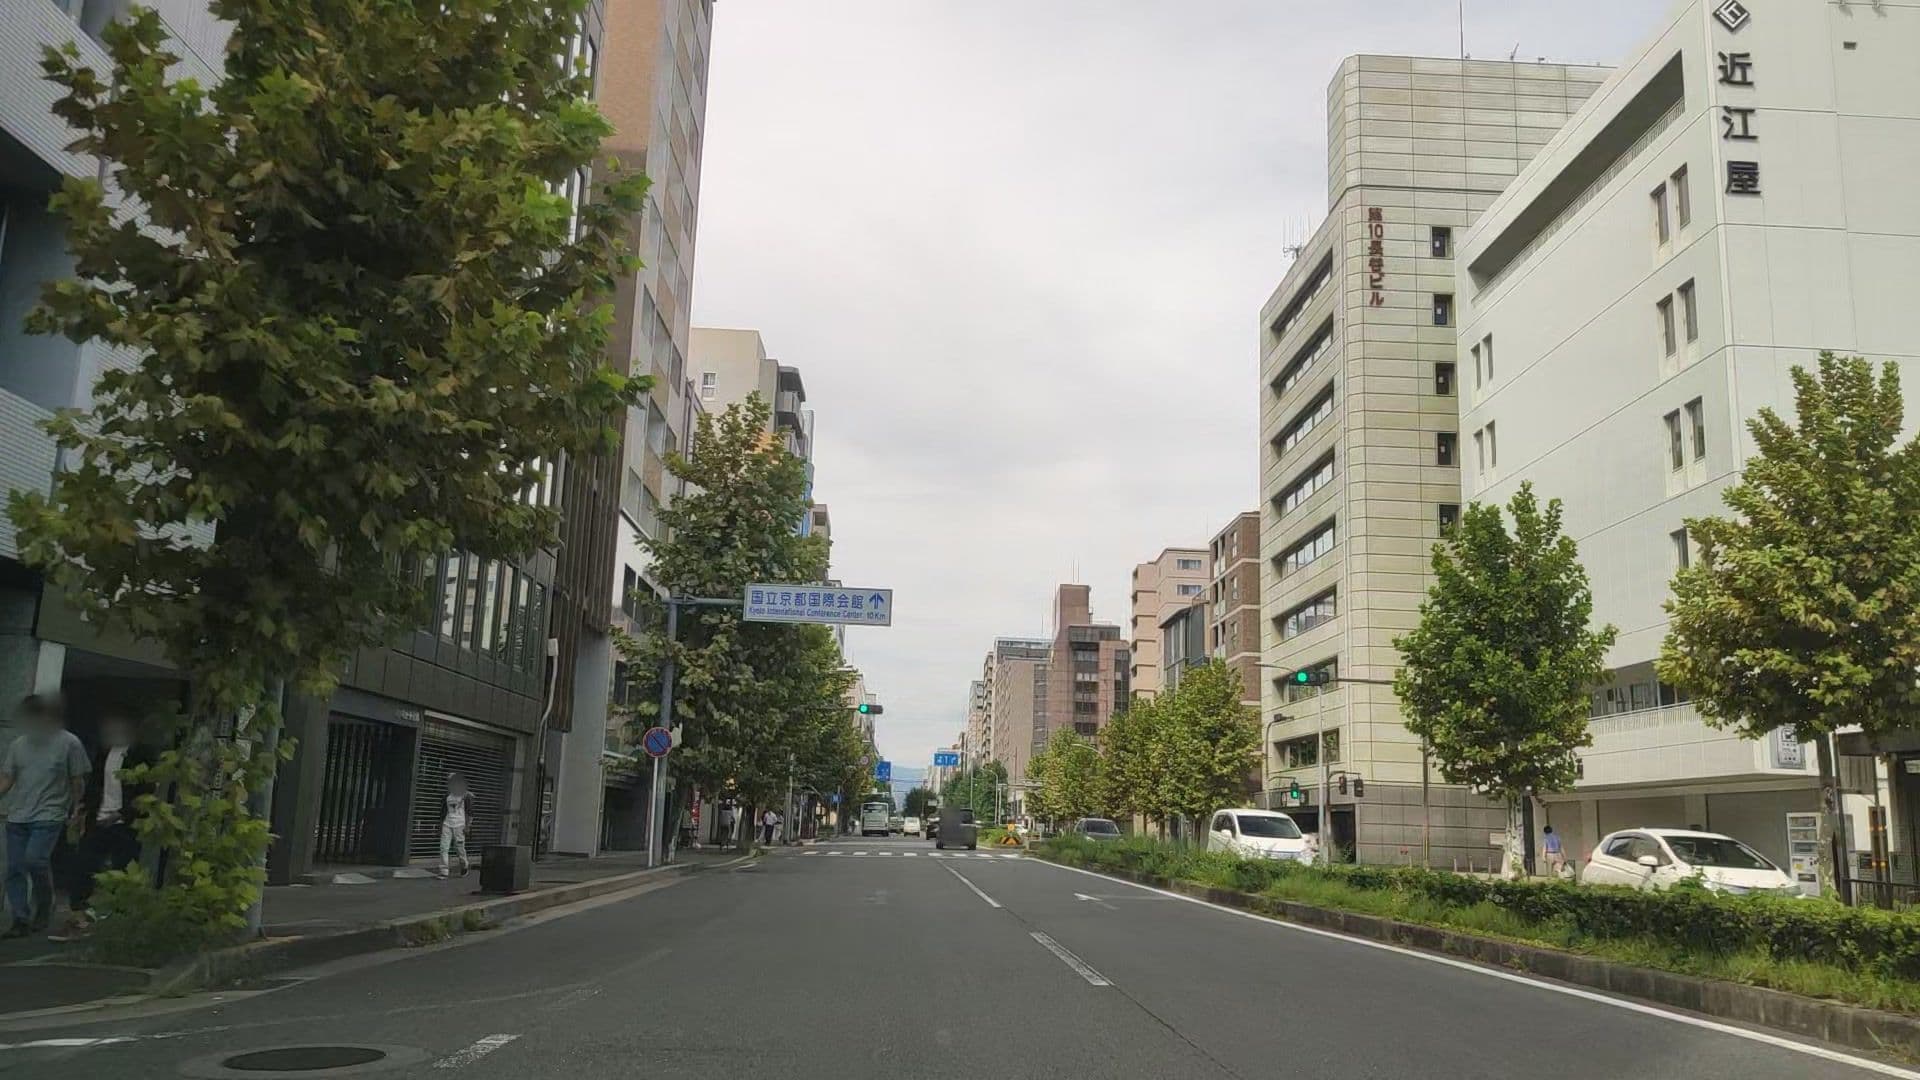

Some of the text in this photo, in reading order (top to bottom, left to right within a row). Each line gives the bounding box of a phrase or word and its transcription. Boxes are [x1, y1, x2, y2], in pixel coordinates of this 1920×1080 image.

[1718, 51, 1761, 195] 近江屋
[751, 590, 864, 609] 国立京都国際会館
